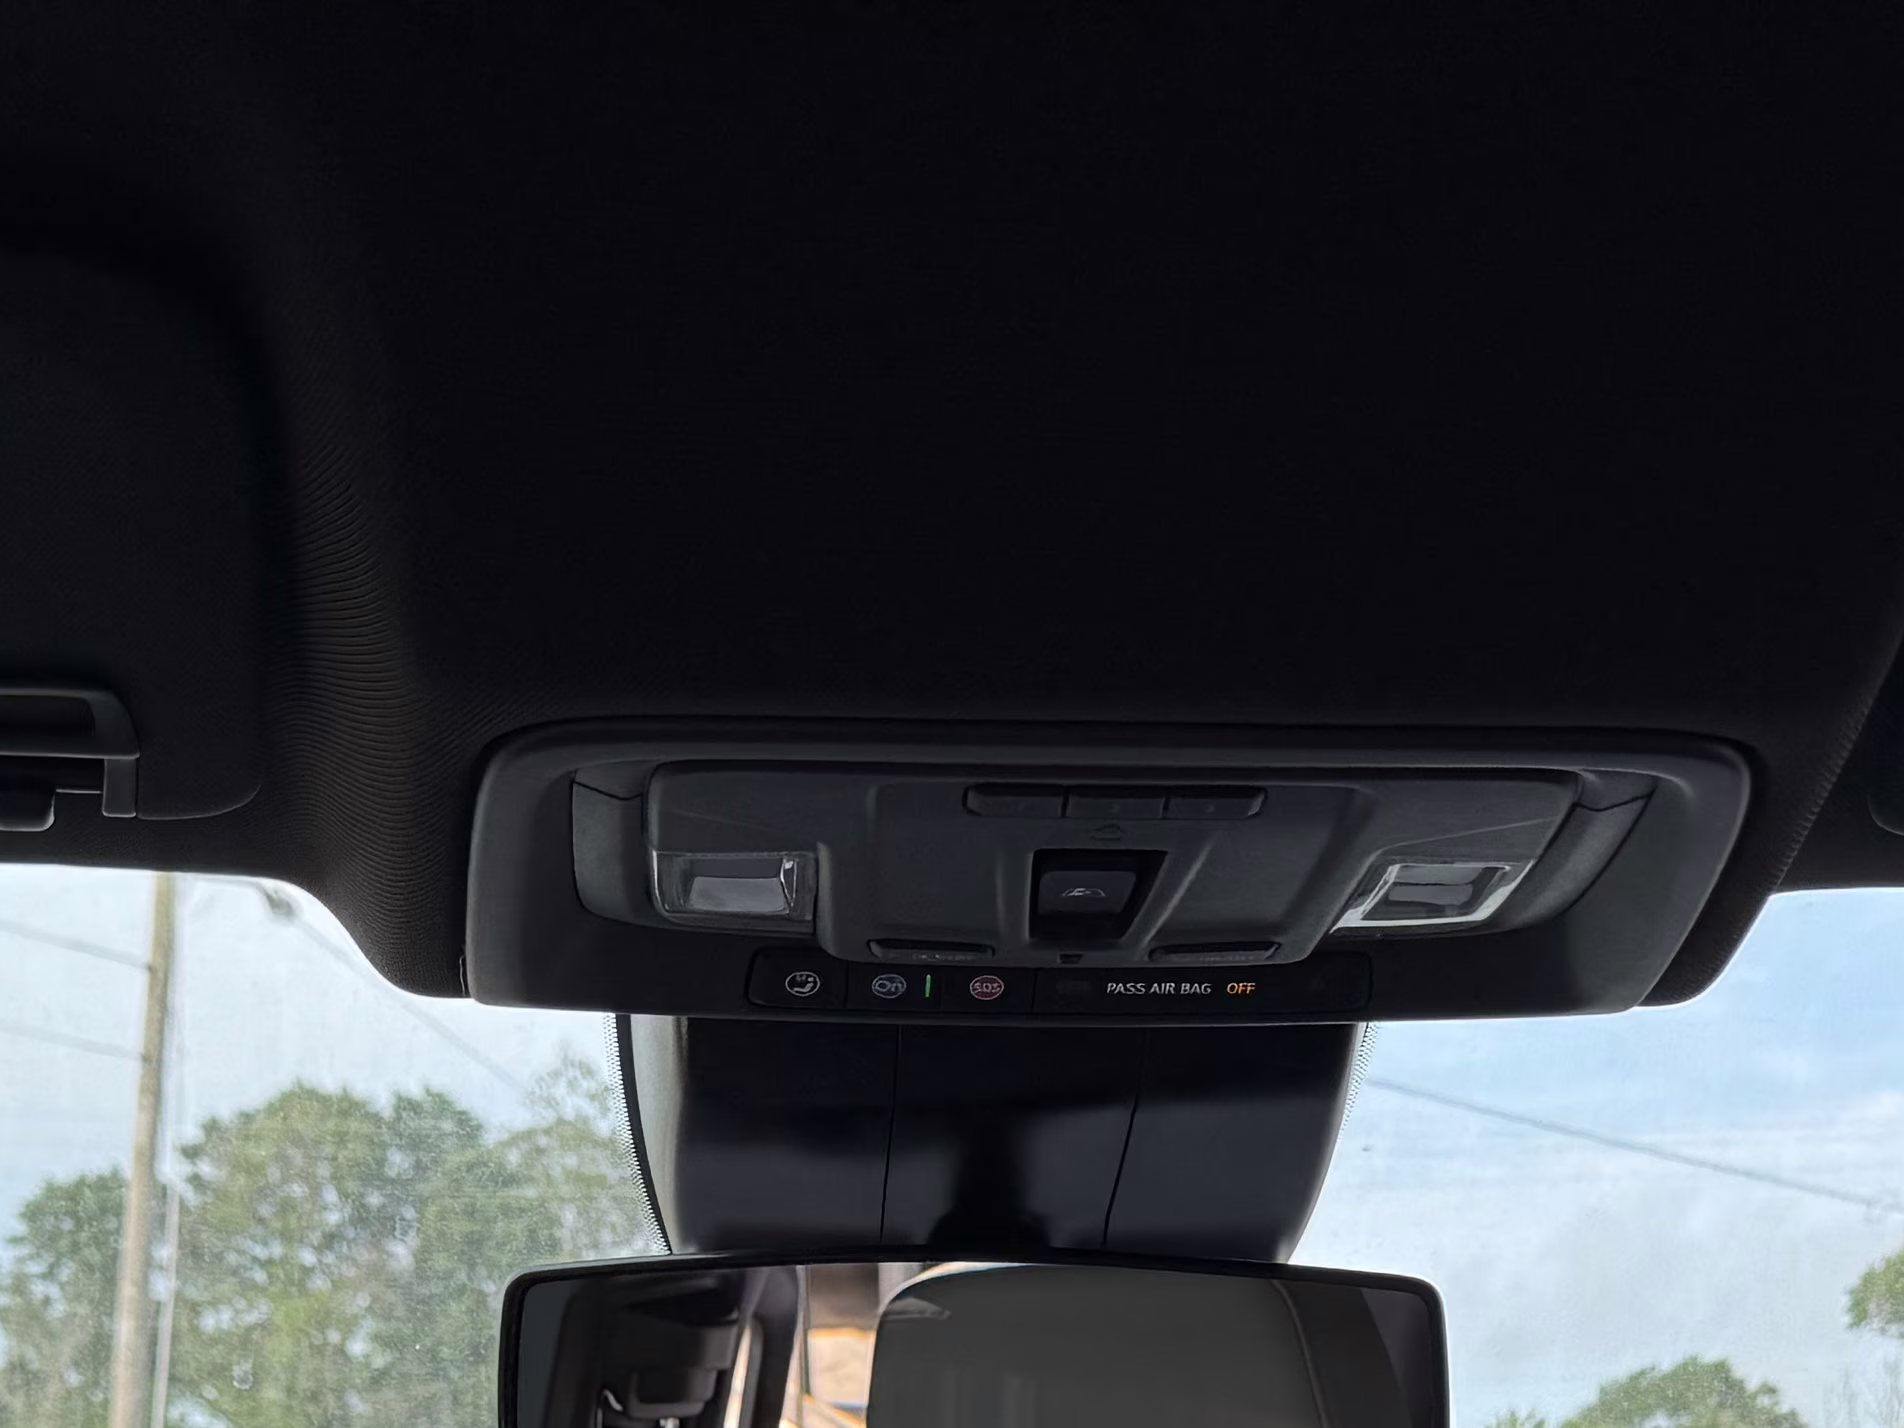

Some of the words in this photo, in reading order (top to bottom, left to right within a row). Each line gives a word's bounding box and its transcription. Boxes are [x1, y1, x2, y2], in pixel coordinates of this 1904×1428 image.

[1106, 981, 1146, 995] PASS
[1149, 981, 1174, 995] AIR
[1180, 981, 1212, 995] BAG
[1226, 981, 1257, 996] OFF
